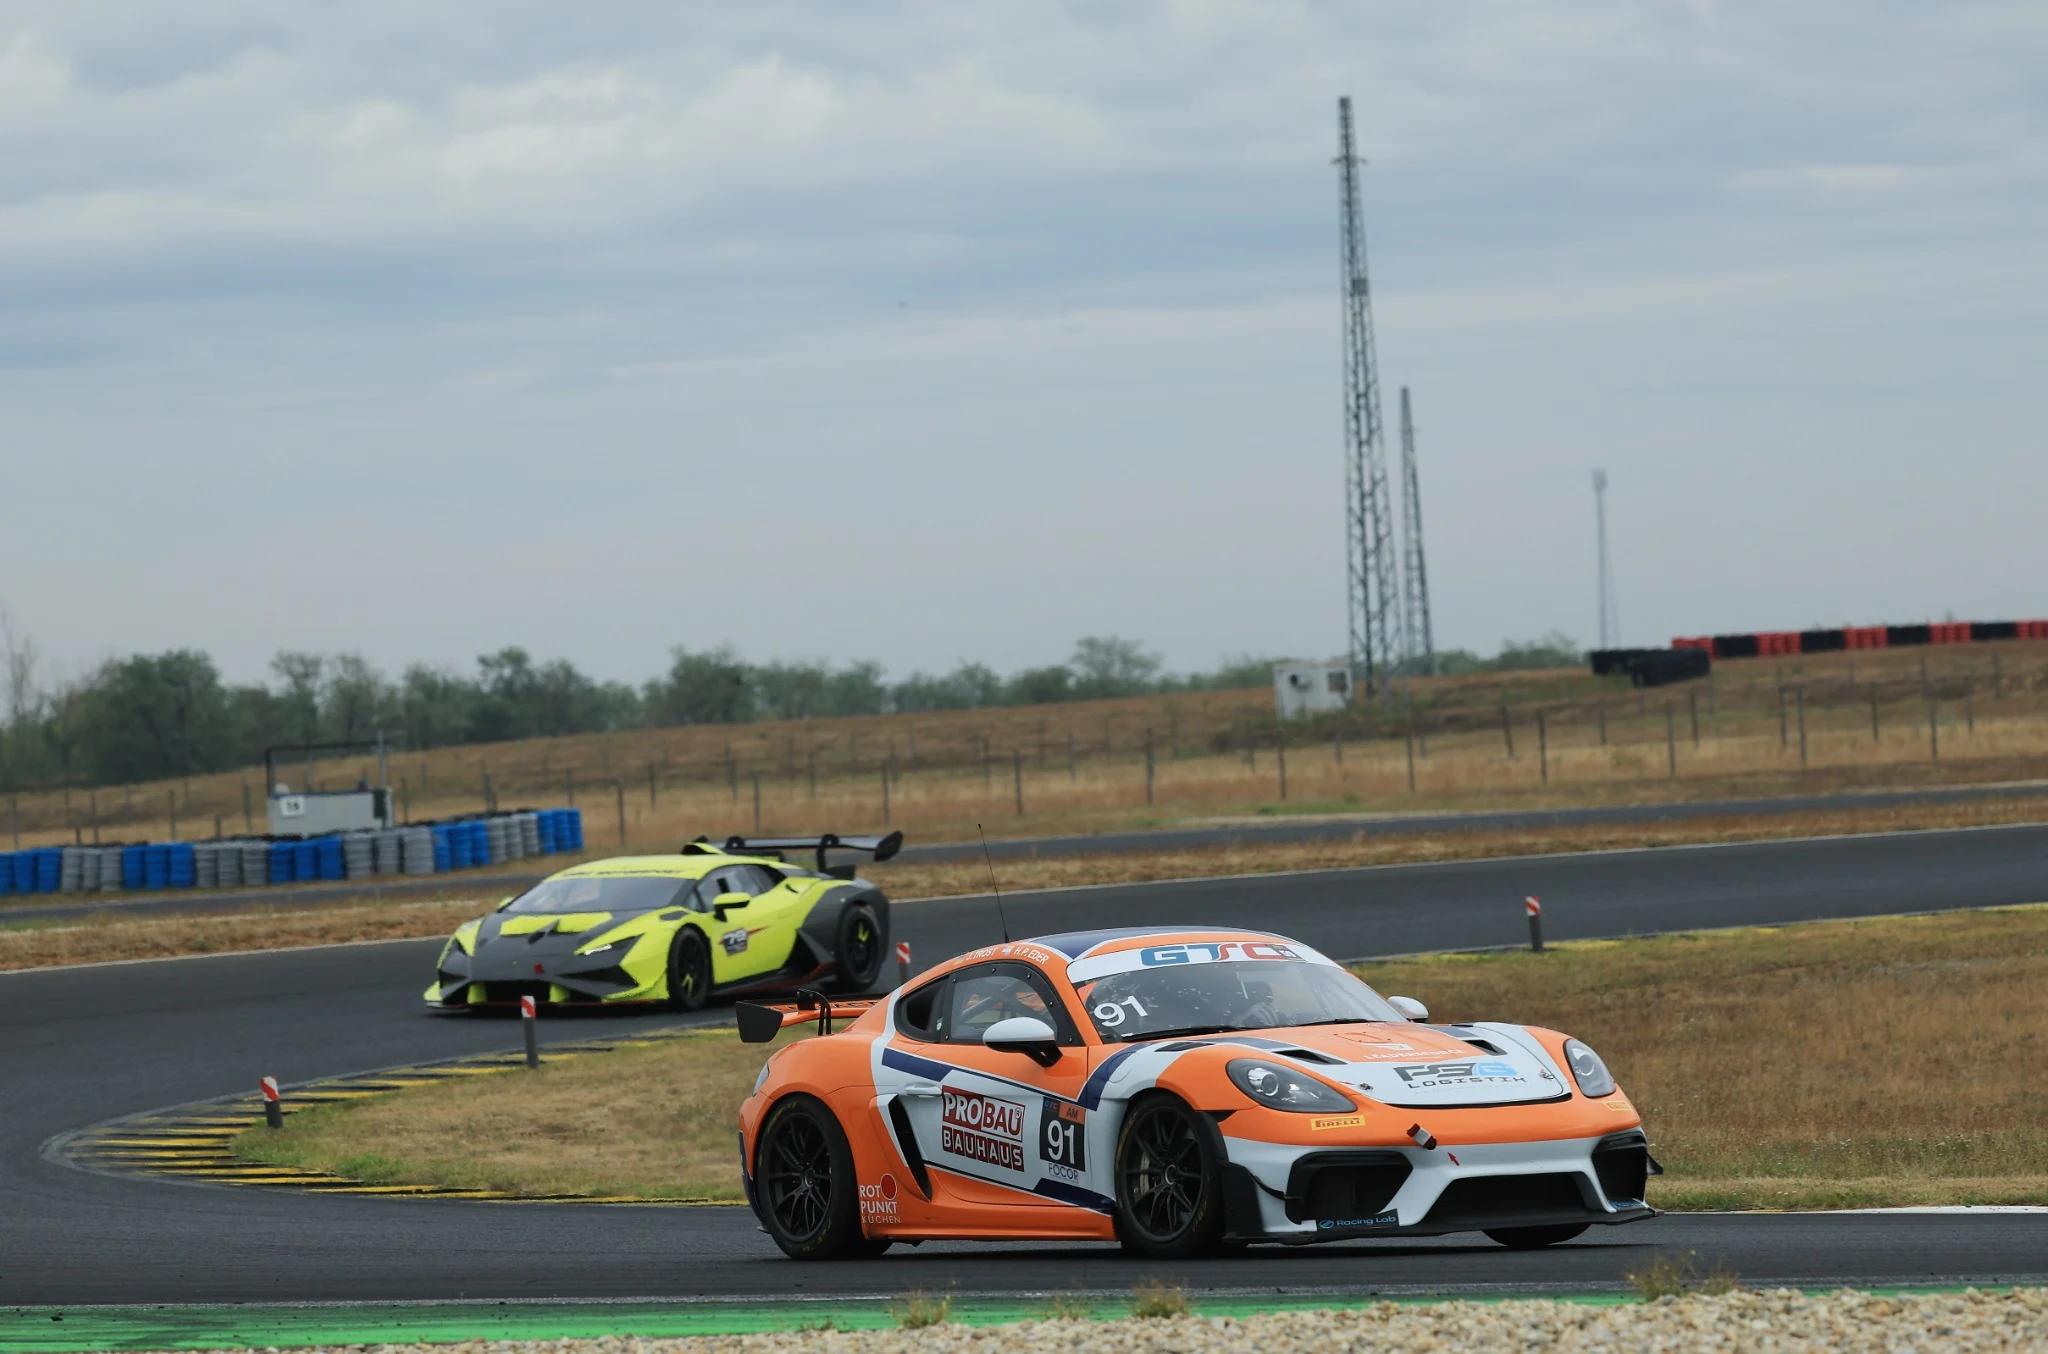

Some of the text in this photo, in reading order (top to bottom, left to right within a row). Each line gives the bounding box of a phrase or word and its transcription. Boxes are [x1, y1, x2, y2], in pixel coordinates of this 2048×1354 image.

[1093, 995, 1148, 1027] 91
[1406, 1077, 1528, 1089] LOGISTIK
[1066, 1107, 1079, 1119] AM
[1315, 1117, 1360, 1128] PIRELLI
[942, 1130, 1023, 1167] BAUHAUS
[1047, 1119, 1075, 1165] 91
[1048, 1163, 1079, 1181] FOCOR
[860, 1185, 881, 1198] ROT
[860, 1201, 898, 1214] PUNKT
[861, 1213, 901, 1224] KÜCHEN
[1375, 1215, 1396, 1223] Lab
